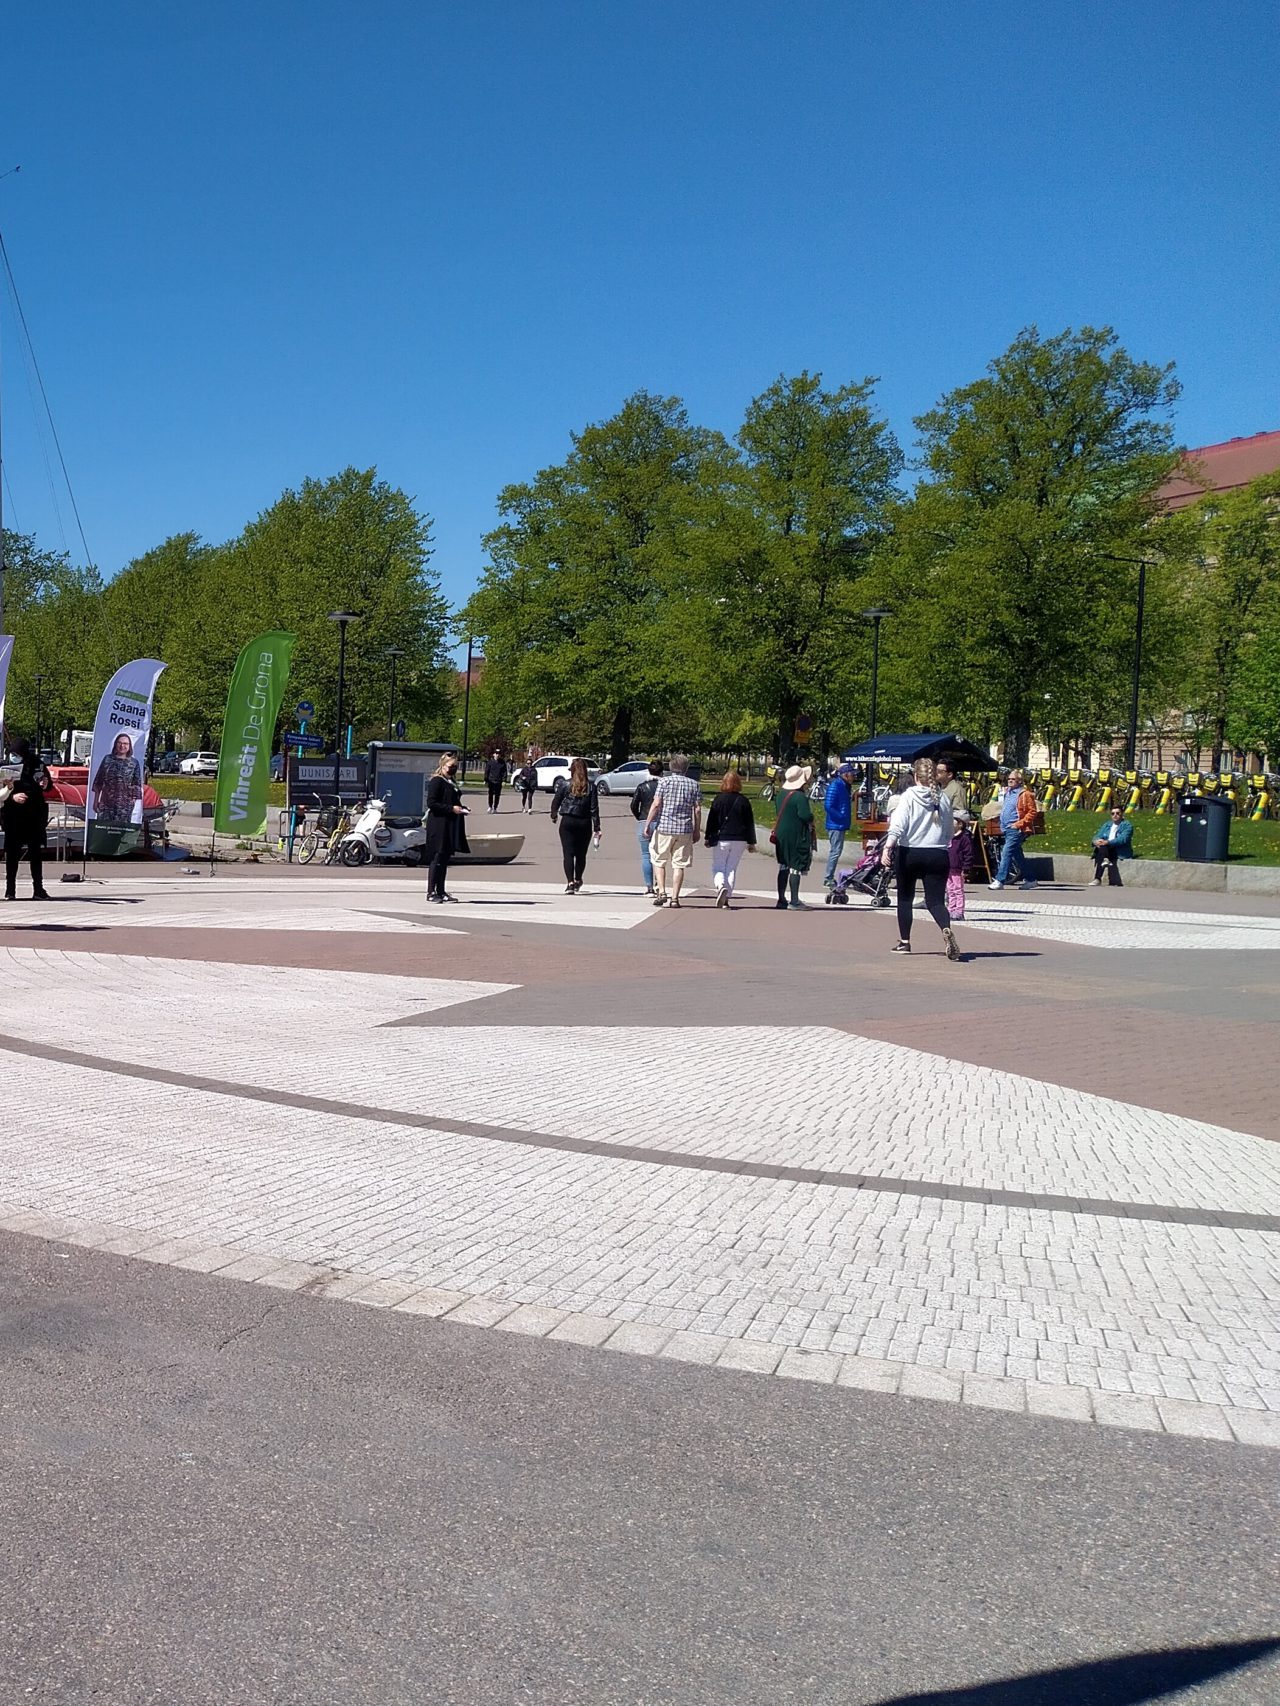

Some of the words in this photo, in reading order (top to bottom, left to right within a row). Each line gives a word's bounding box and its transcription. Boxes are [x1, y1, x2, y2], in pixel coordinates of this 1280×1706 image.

[247, 653, 273, 709] Gröna
[110, 713, 141, 729] Rossi
[112, 700, 146, 717] Saana
[243, 714, 264, 740] De
[229, 744, 258, 821] Vihreät
